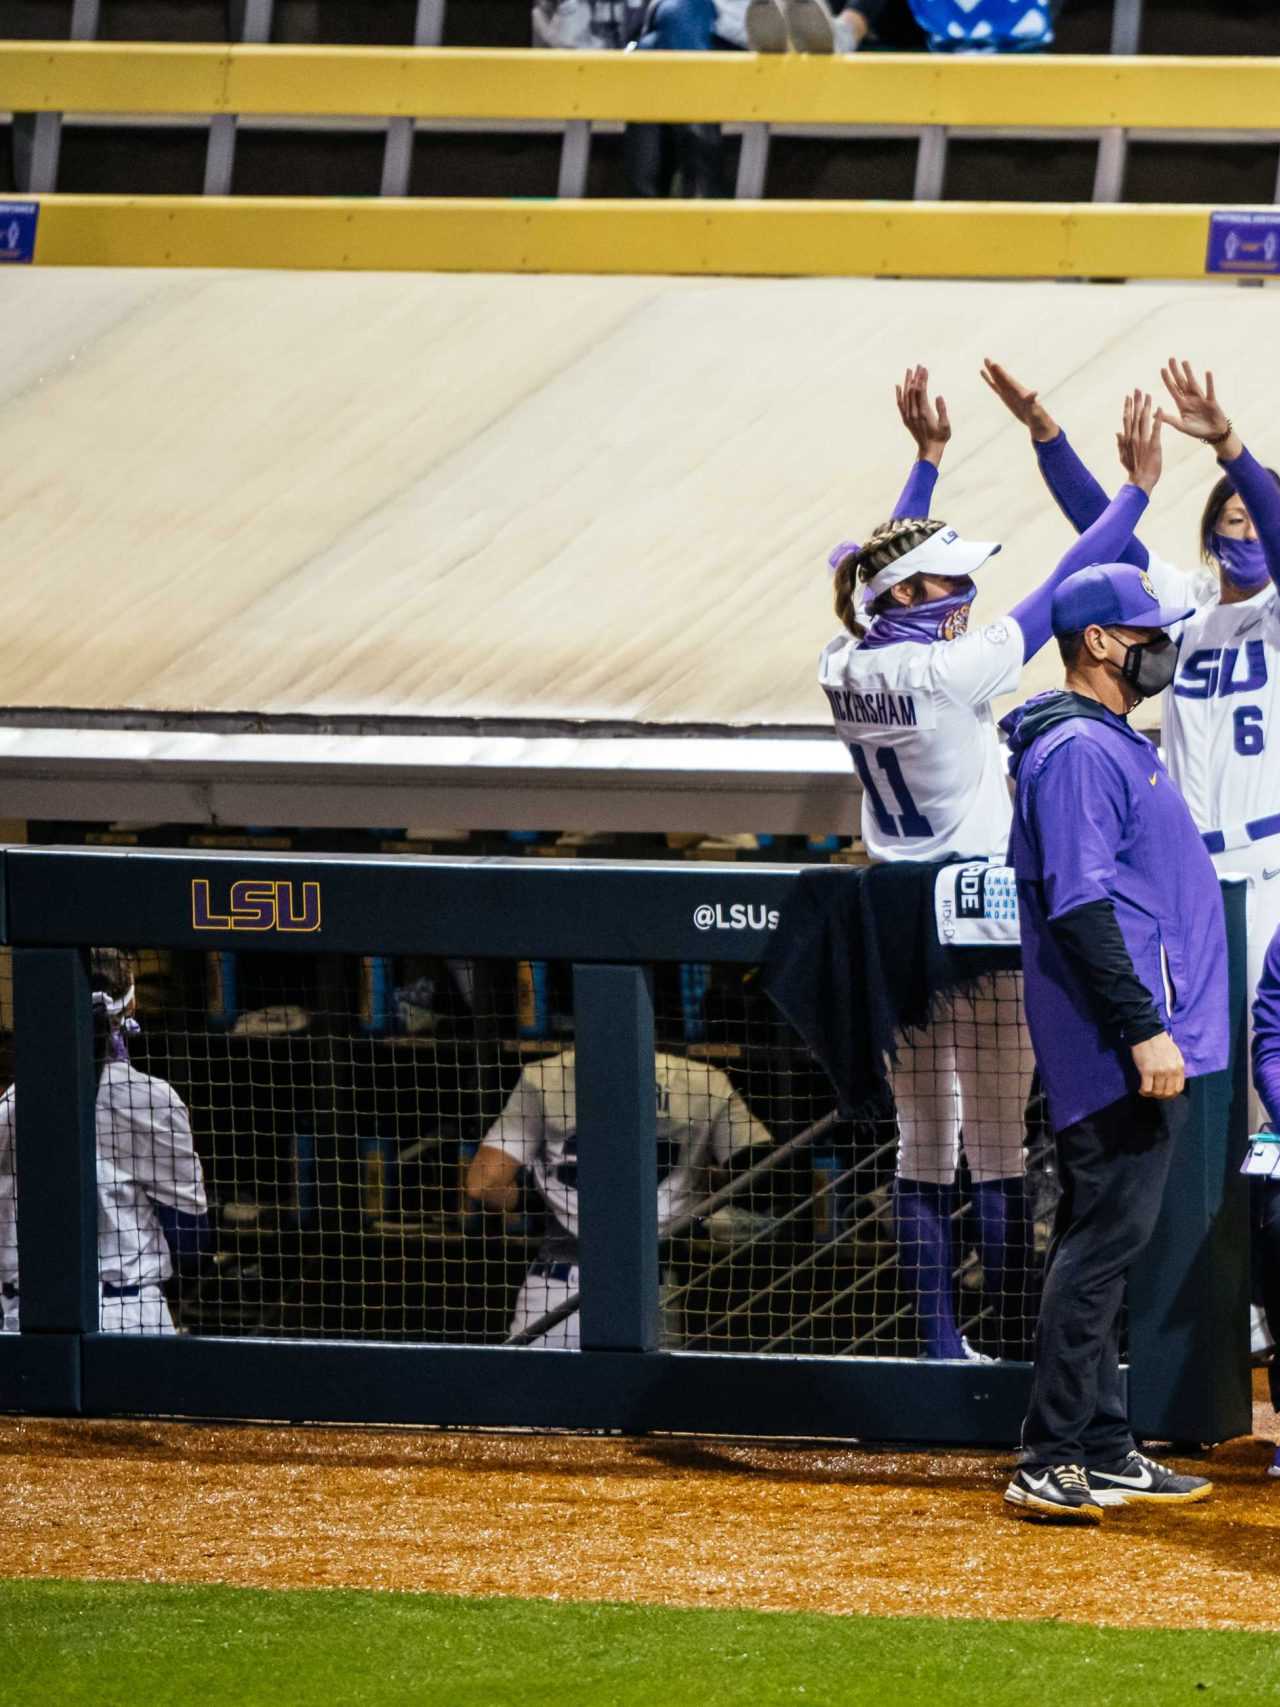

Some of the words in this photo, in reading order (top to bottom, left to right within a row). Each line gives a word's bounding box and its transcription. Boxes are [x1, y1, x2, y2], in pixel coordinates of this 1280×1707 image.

[1173, 632, 1268, 699] SU
[827, 690, 918, 726] ICKERSHAM
[1233, 704, 1264, 756] 6
[850, 743, 935, 838] 11
[192, 879, 322, 932] LSU
[693, 903, 780, 931] @LSUs
